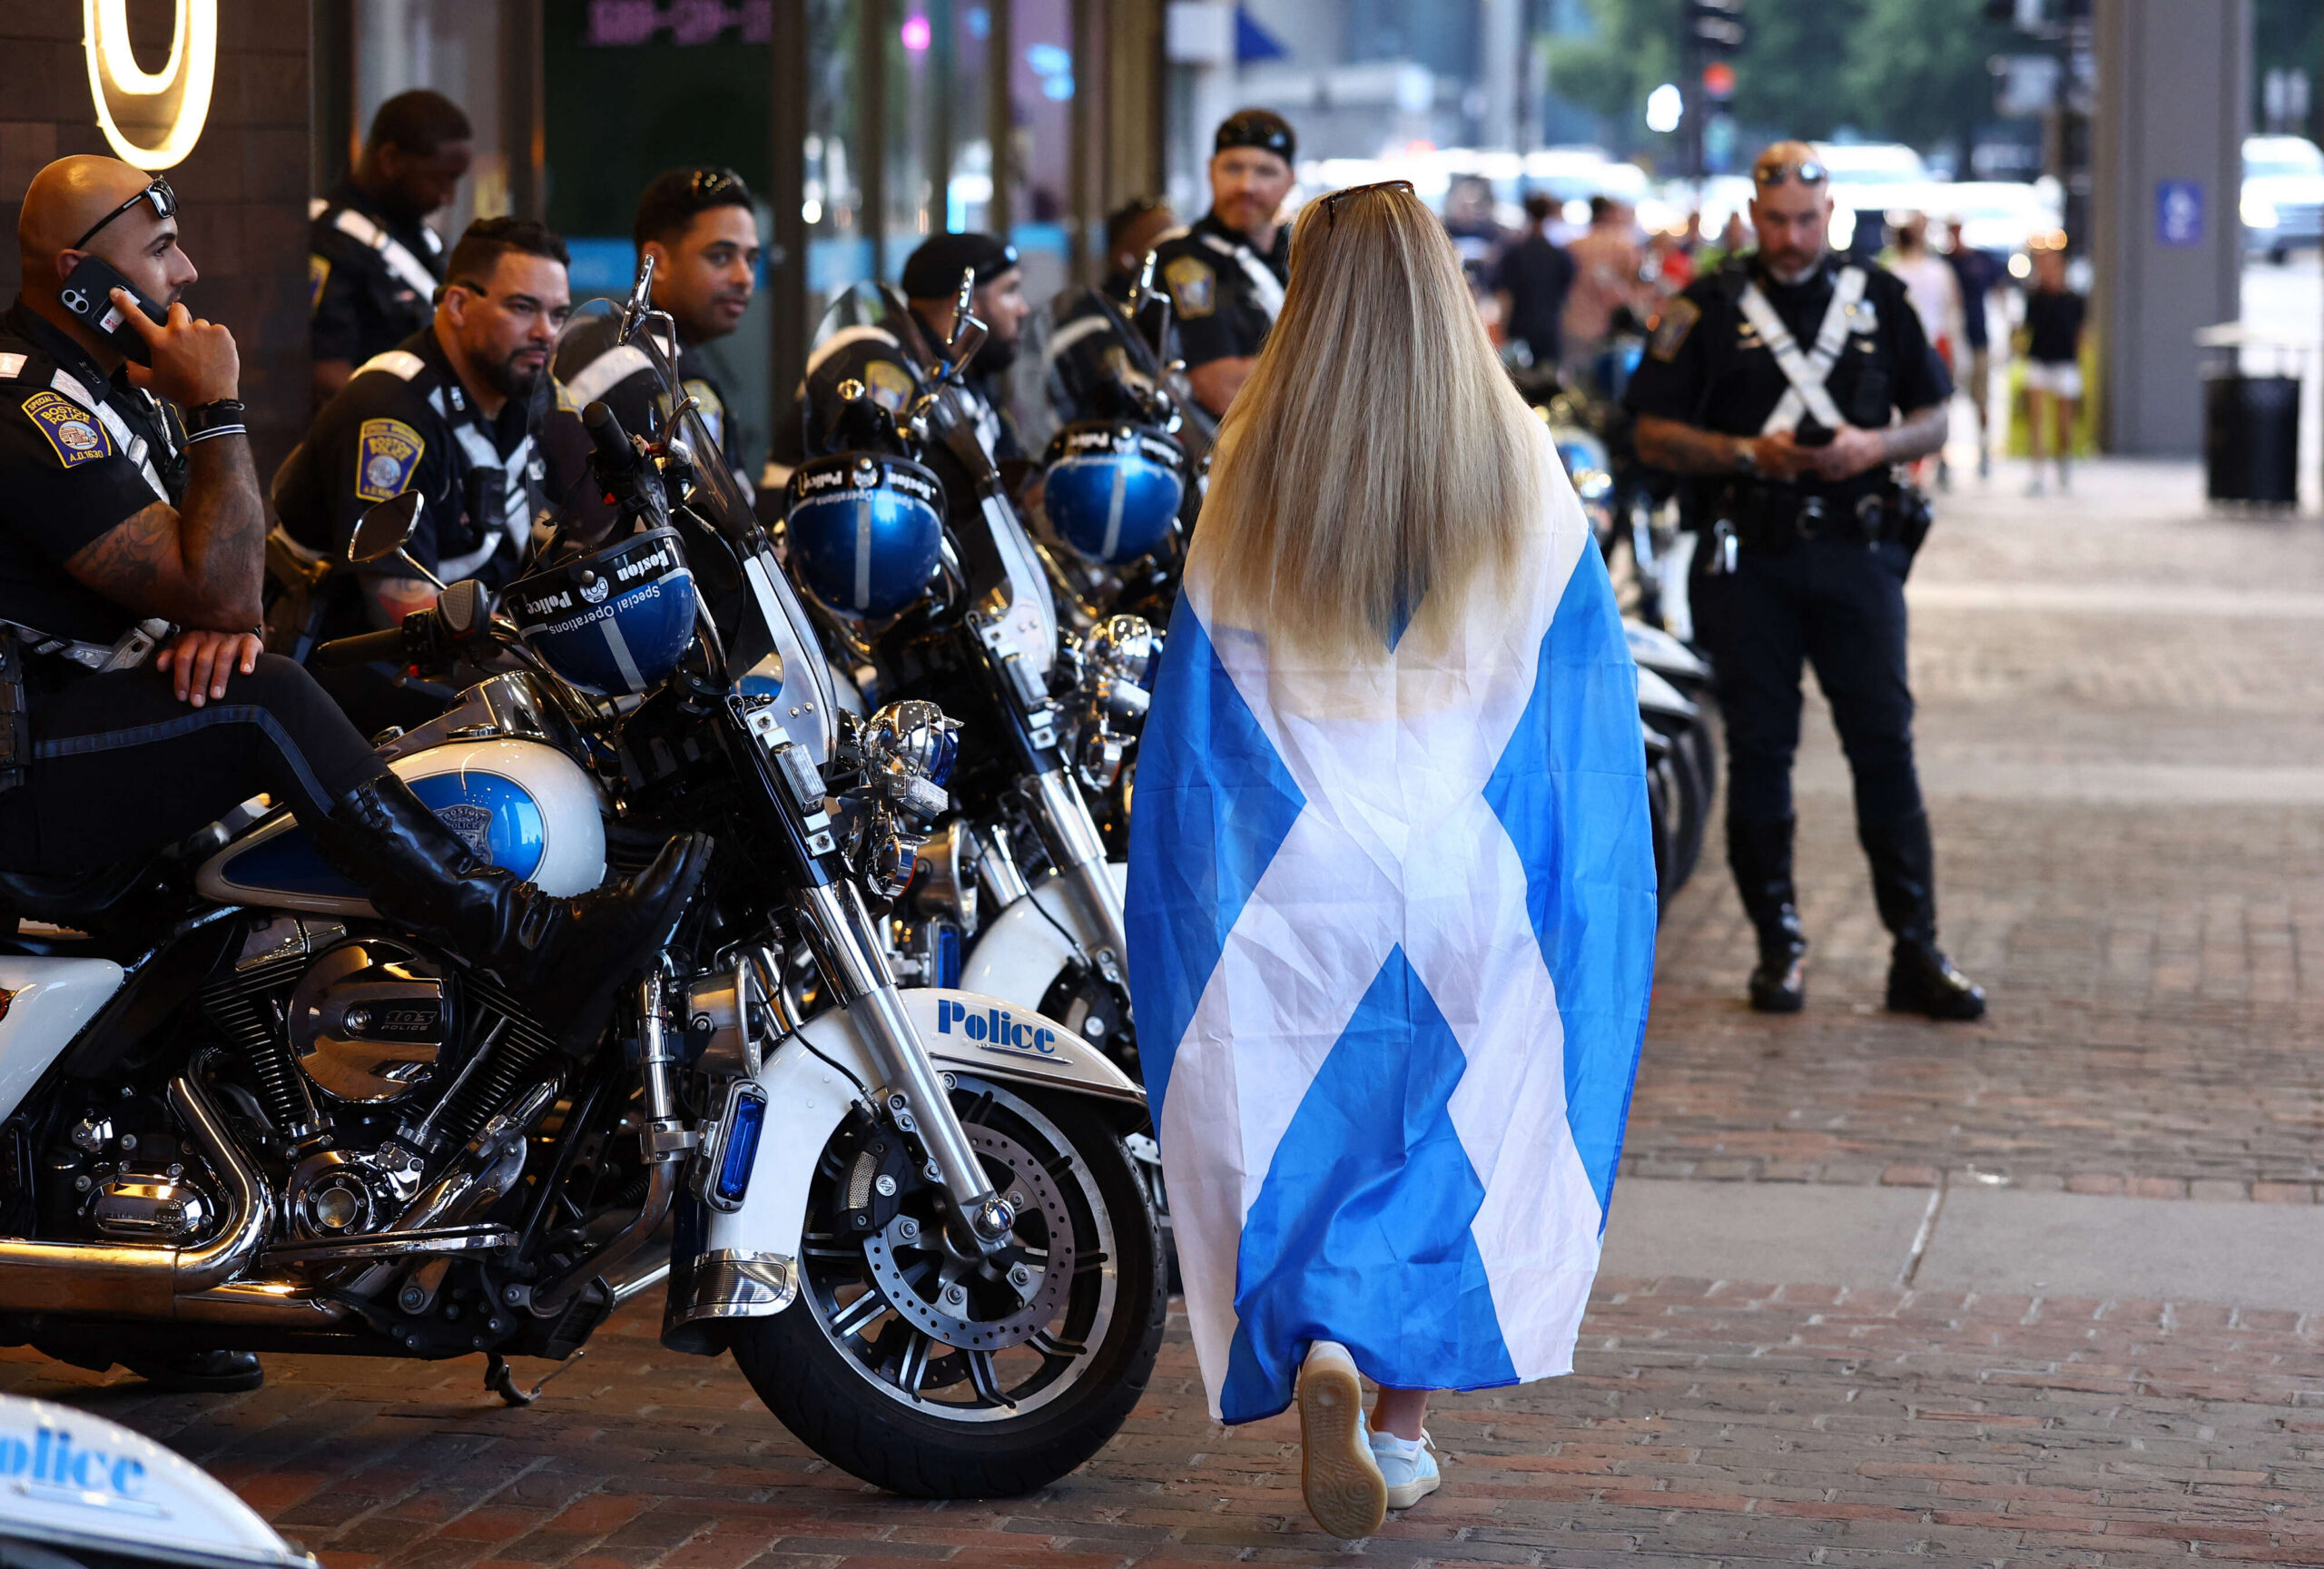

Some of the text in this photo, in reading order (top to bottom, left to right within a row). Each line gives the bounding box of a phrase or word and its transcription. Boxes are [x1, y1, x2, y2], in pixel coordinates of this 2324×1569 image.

[27, 395, 54, 411] SPECIAL
[40, 405, 91, 420] BOSTON
[48, 413, 91, 426] POLICE
[526, 549, 671, 616] Boston Police
[584, 580, 607, 598] DOT
[547, 584, 661, 635] Special Operations
[938, 999, 1056, 1054] Police
[0, 1426, 146, 1495] olice
